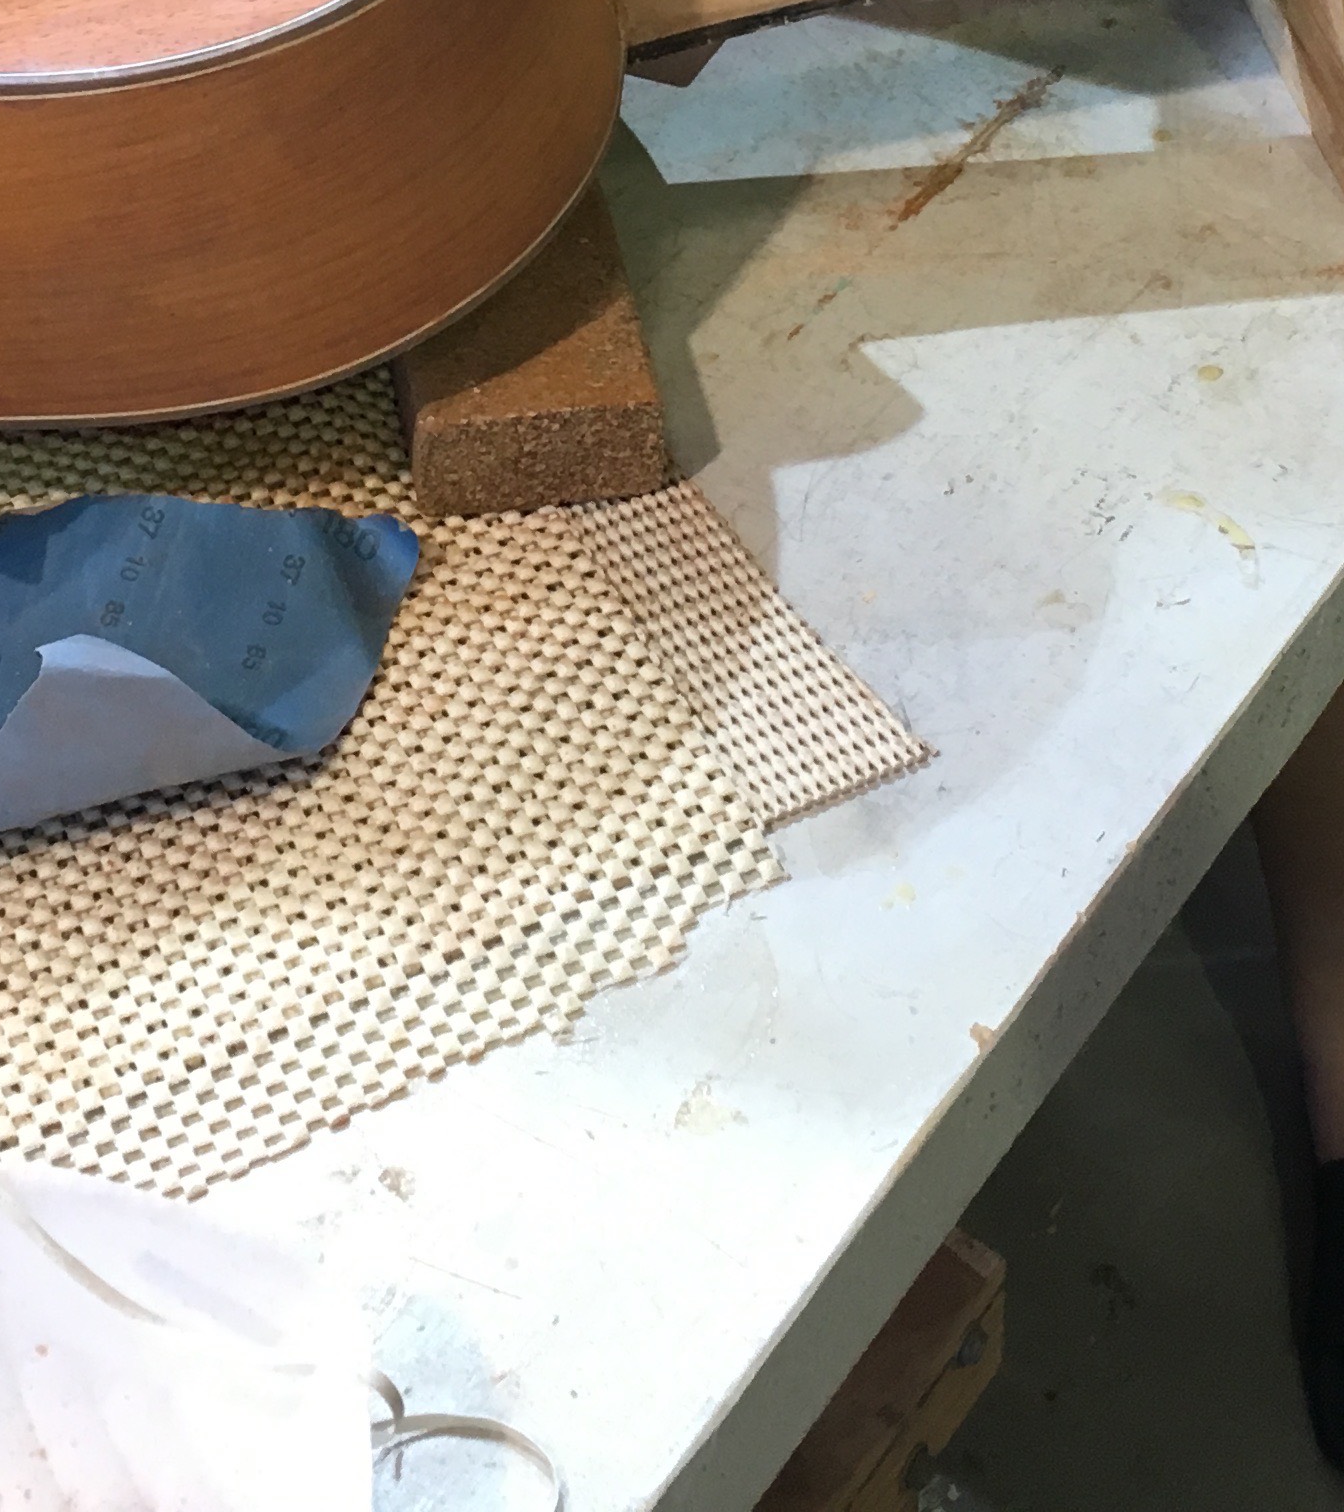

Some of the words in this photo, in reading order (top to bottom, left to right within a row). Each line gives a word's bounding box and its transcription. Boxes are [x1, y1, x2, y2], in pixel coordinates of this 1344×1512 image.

[138, 504, 166, 541] 37
[120, 555, 147, 582] 10
[280, 553, 306, 586] 37
[99, 599, 126, 629] 85
[261, 600, 287, 626] 10
